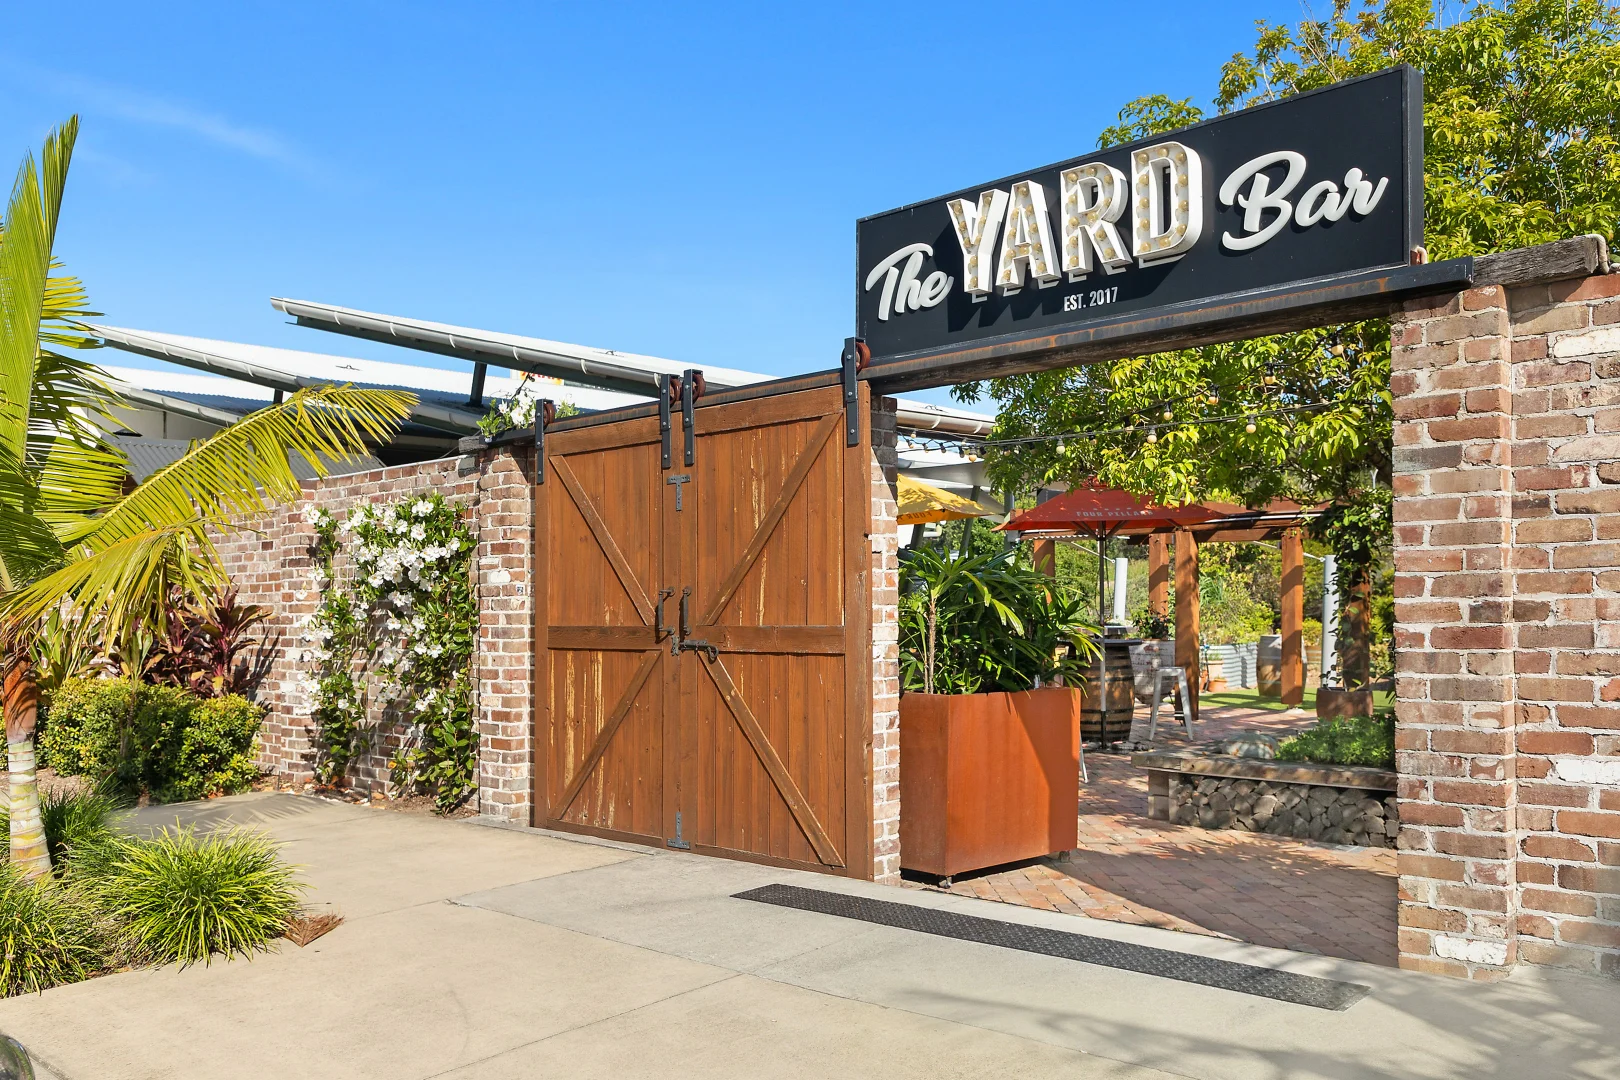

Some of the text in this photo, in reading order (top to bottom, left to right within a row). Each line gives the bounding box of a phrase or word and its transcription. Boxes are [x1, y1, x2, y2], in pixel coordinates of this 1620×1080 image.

[866, 141, 1389, 321] The YARD Bar
[1064, 286, 1118, 312] EST. 2017
